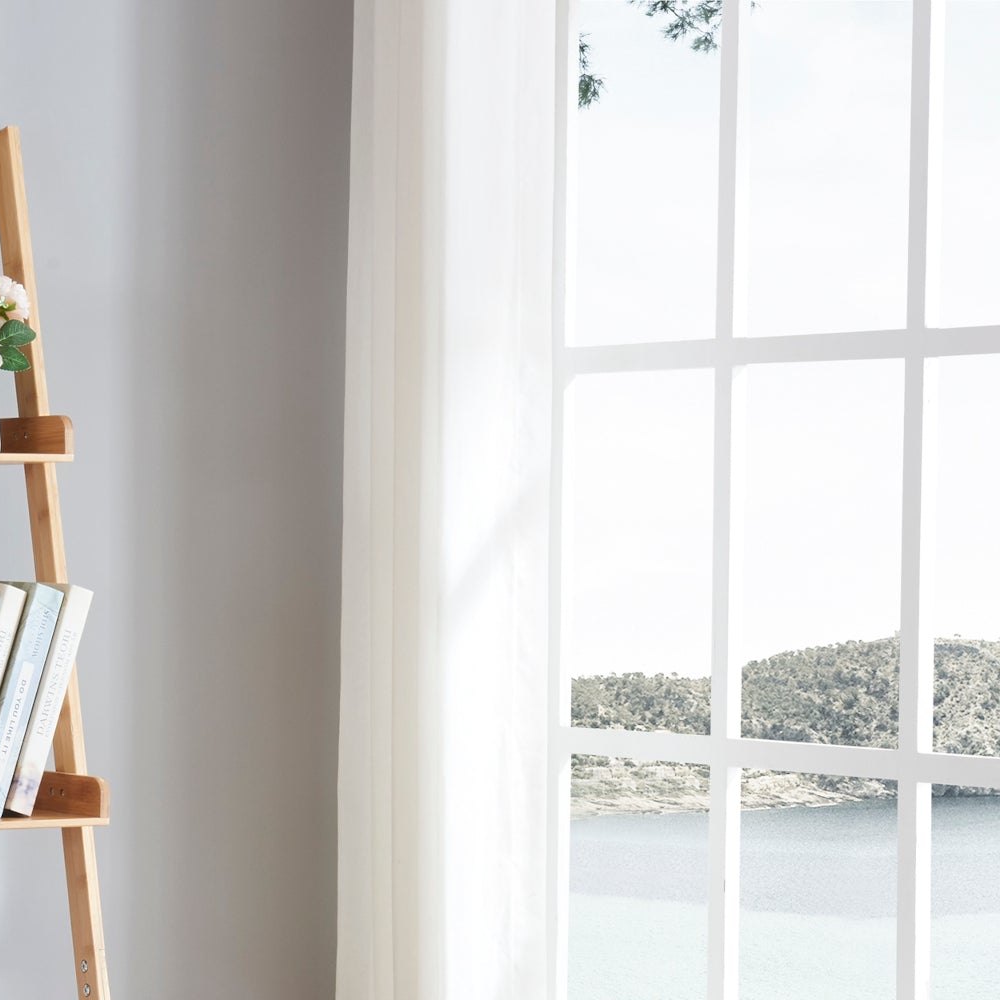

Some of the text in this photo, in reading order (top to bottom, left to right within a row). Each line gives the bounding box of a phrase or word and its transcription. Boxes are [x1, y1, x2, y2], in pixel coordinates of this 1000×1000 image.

[2, 679, 27, 755] DO YOU LIKE IT
